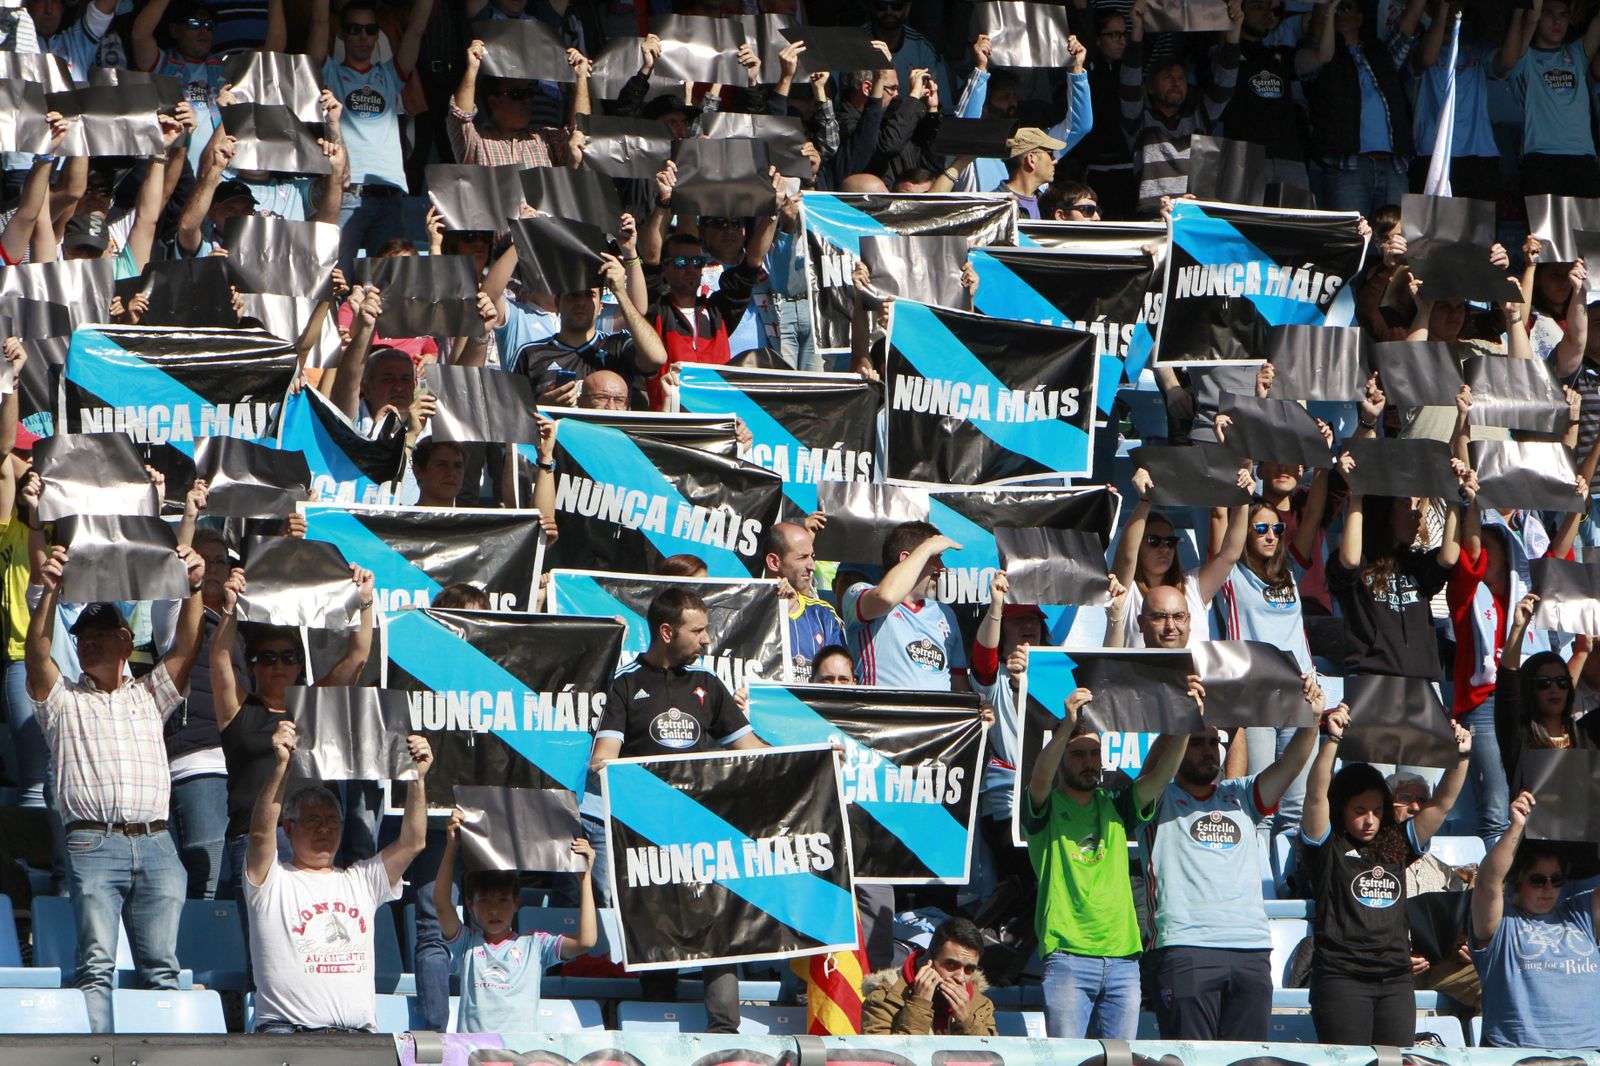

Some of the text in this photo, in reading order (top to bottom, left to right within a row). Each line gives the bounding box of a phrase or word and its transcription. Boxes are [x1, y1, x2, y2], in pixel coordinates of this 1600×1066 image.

[350, 92, 382, 104] Estrella
[352, 101, 380, 112] Galicia
[1265, 262, 1343, 305] MÁIS
[996, 384, 1080, 424] MÁIS
[796, 441, 873, 485] MÁIS
[910, 644, 942, 662] Estrella
[657, 719, 694, 730] Estrella
[660, 728, 693, 739] Galicia
[884, 758, 965, 805] MÁIS
[1196, 820, 1235, 833] Estrella
[1198, 831, 1233, 843] Galicia
[742, 826, 835, 878] MÁIS
[1359, 876, 1395, 889] Estrella
[1360, 887, 1393, 899] Galicia
[1544, 959, 1557, 969] for
[1565, 957, 1598, 976] Ride
